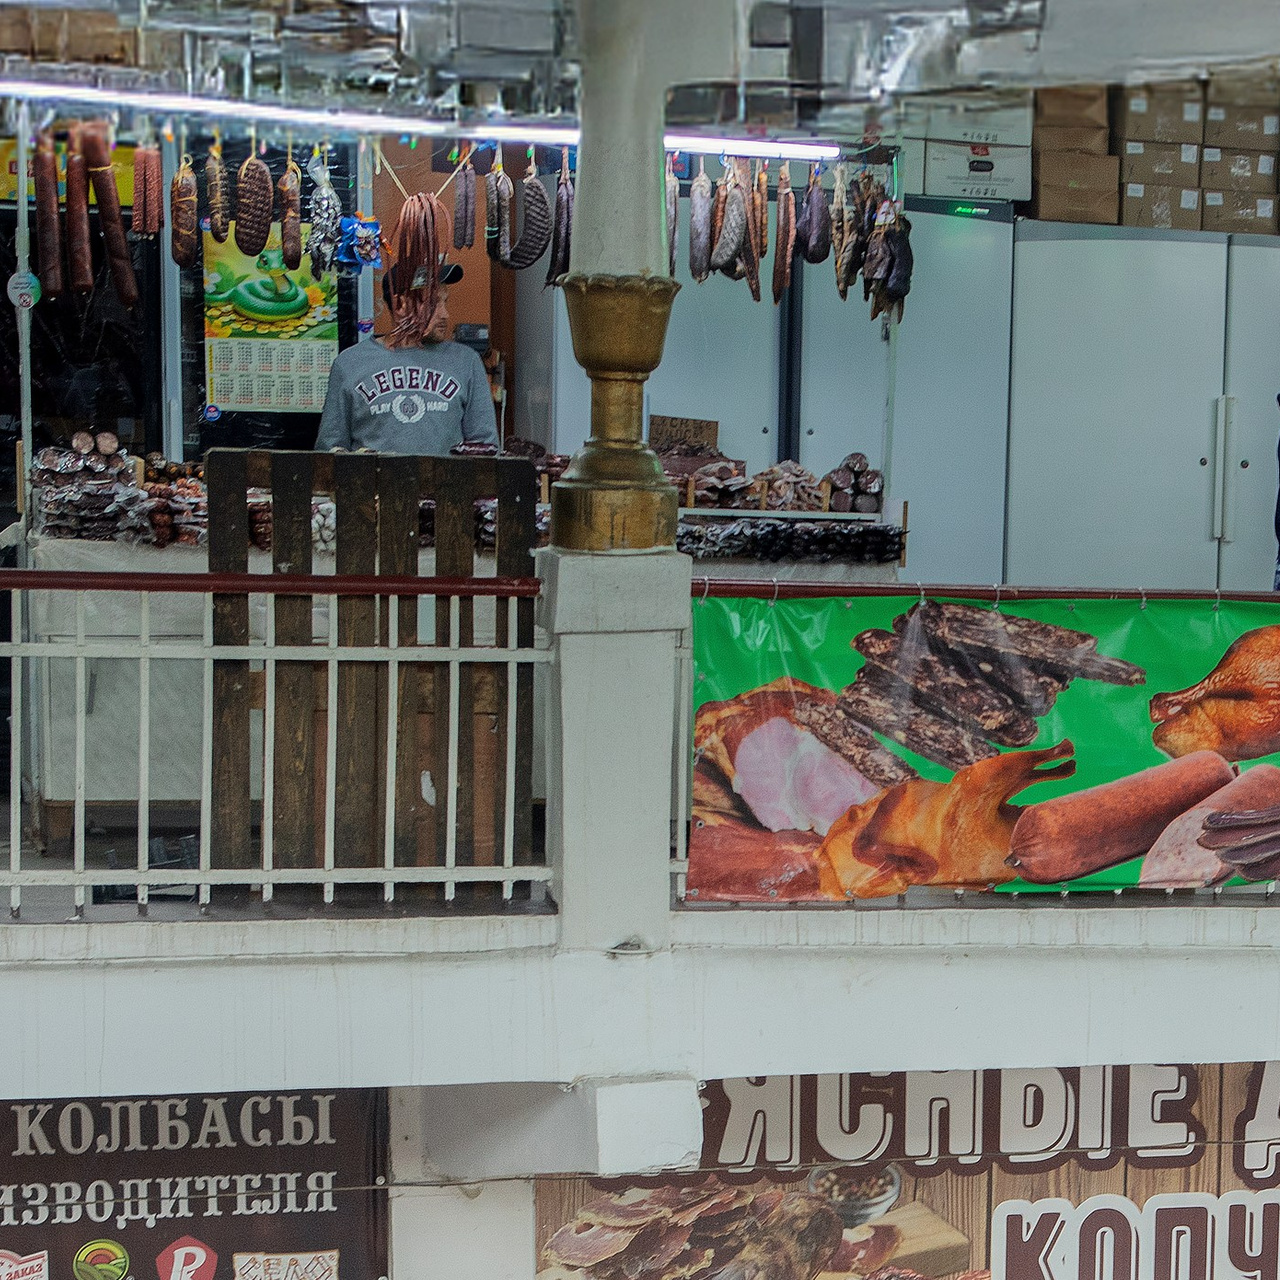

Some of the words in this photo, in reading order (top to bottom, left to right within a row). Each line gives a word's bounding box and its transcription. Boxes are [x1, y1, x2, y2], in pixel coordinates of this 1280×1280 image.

[355, 365, 461, 404] LEGEND
[369, 403, 392, 416] PLAY
[426, 401, 449, 412] HARD
[11, 1095, 337, 1157] КОЛБАСЫ
[718, 1062, 1196, 1173] ЯСНЫЕ
